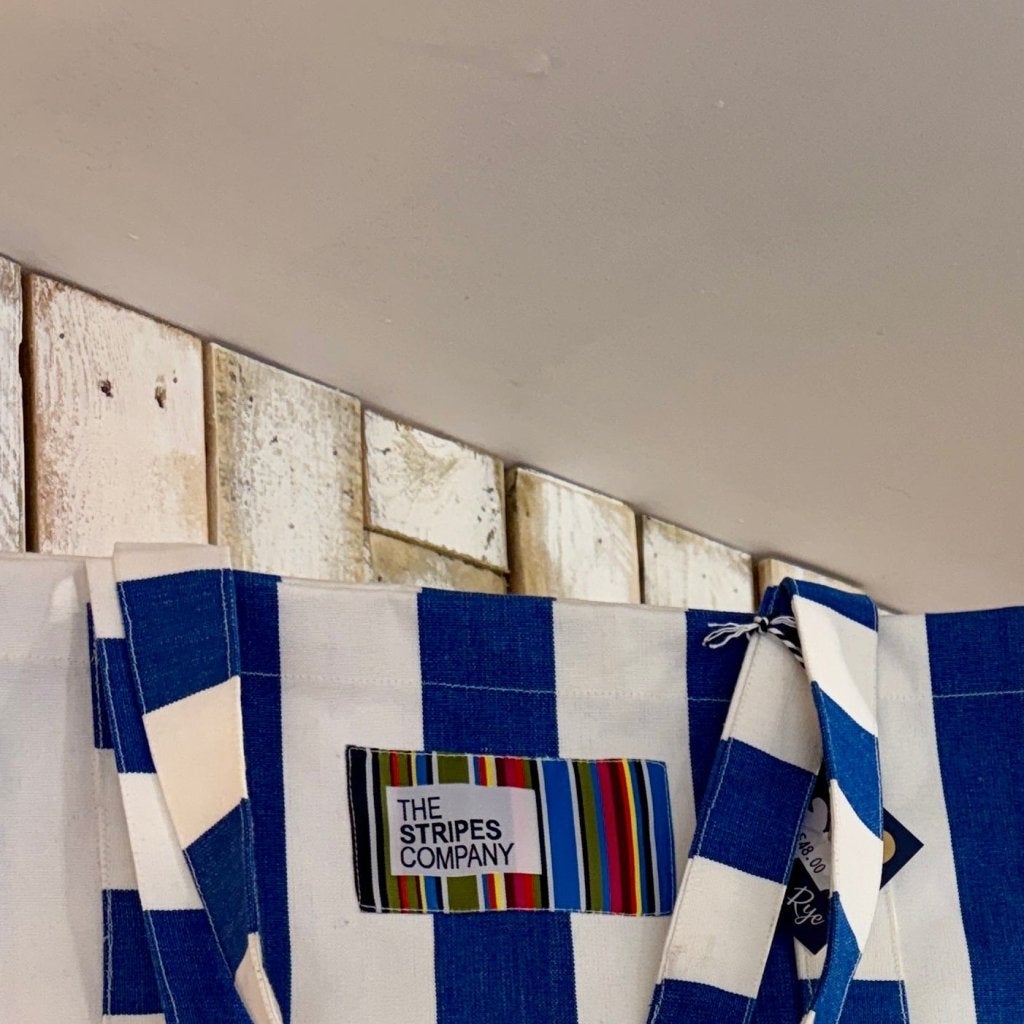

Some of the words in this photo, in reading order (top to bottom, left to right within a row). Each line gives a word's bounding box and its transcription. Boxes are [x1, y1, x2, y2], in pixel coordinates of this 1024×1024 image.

[397, 796, 441, 821] THE
[399, 819, 502, 844] STRIPES
[400, 843, 515, 870] COMPANY
[787, 886, 825, 925] Rye
